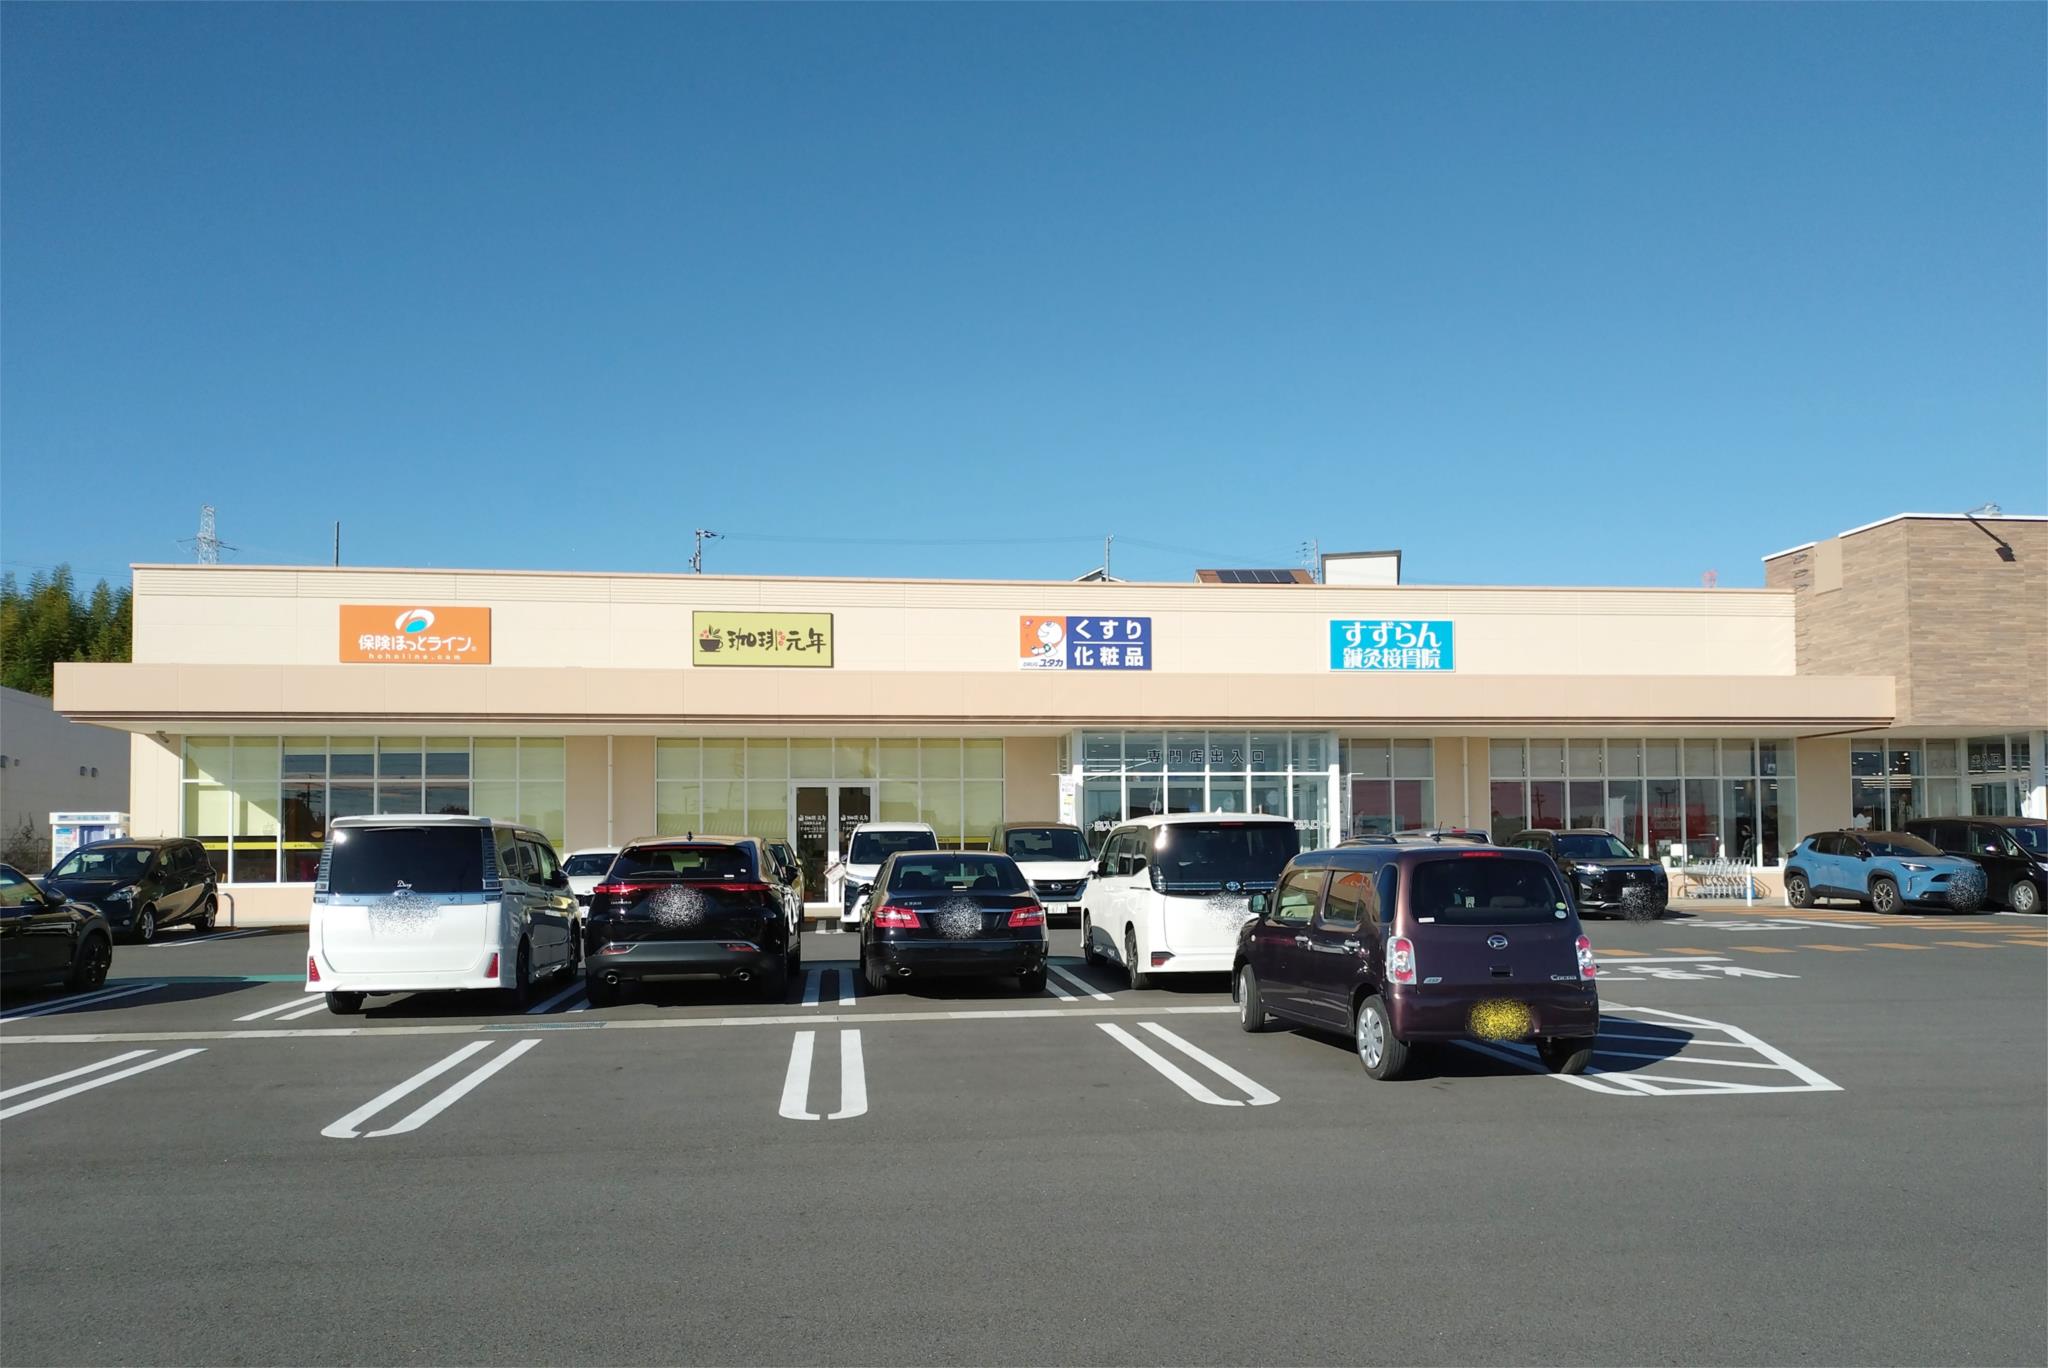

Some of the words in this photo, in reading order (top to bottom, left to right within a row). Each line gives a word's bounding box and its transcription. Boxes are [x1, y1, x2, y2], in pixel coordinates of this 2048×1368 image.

[1075, 619, 1142, 639] くすり
[1342, 621, 1442, 648] すずらん
[727, 627, 826, 653] 珈琲元年
[1039, 658, 1064, 667] ユタカ
[1074, 646, 1144, 666] 化粧品
[1343, 647, 1440, 669] 鍼灸接骨院
[1147, 749, 1265, 763] 専門店出入口
